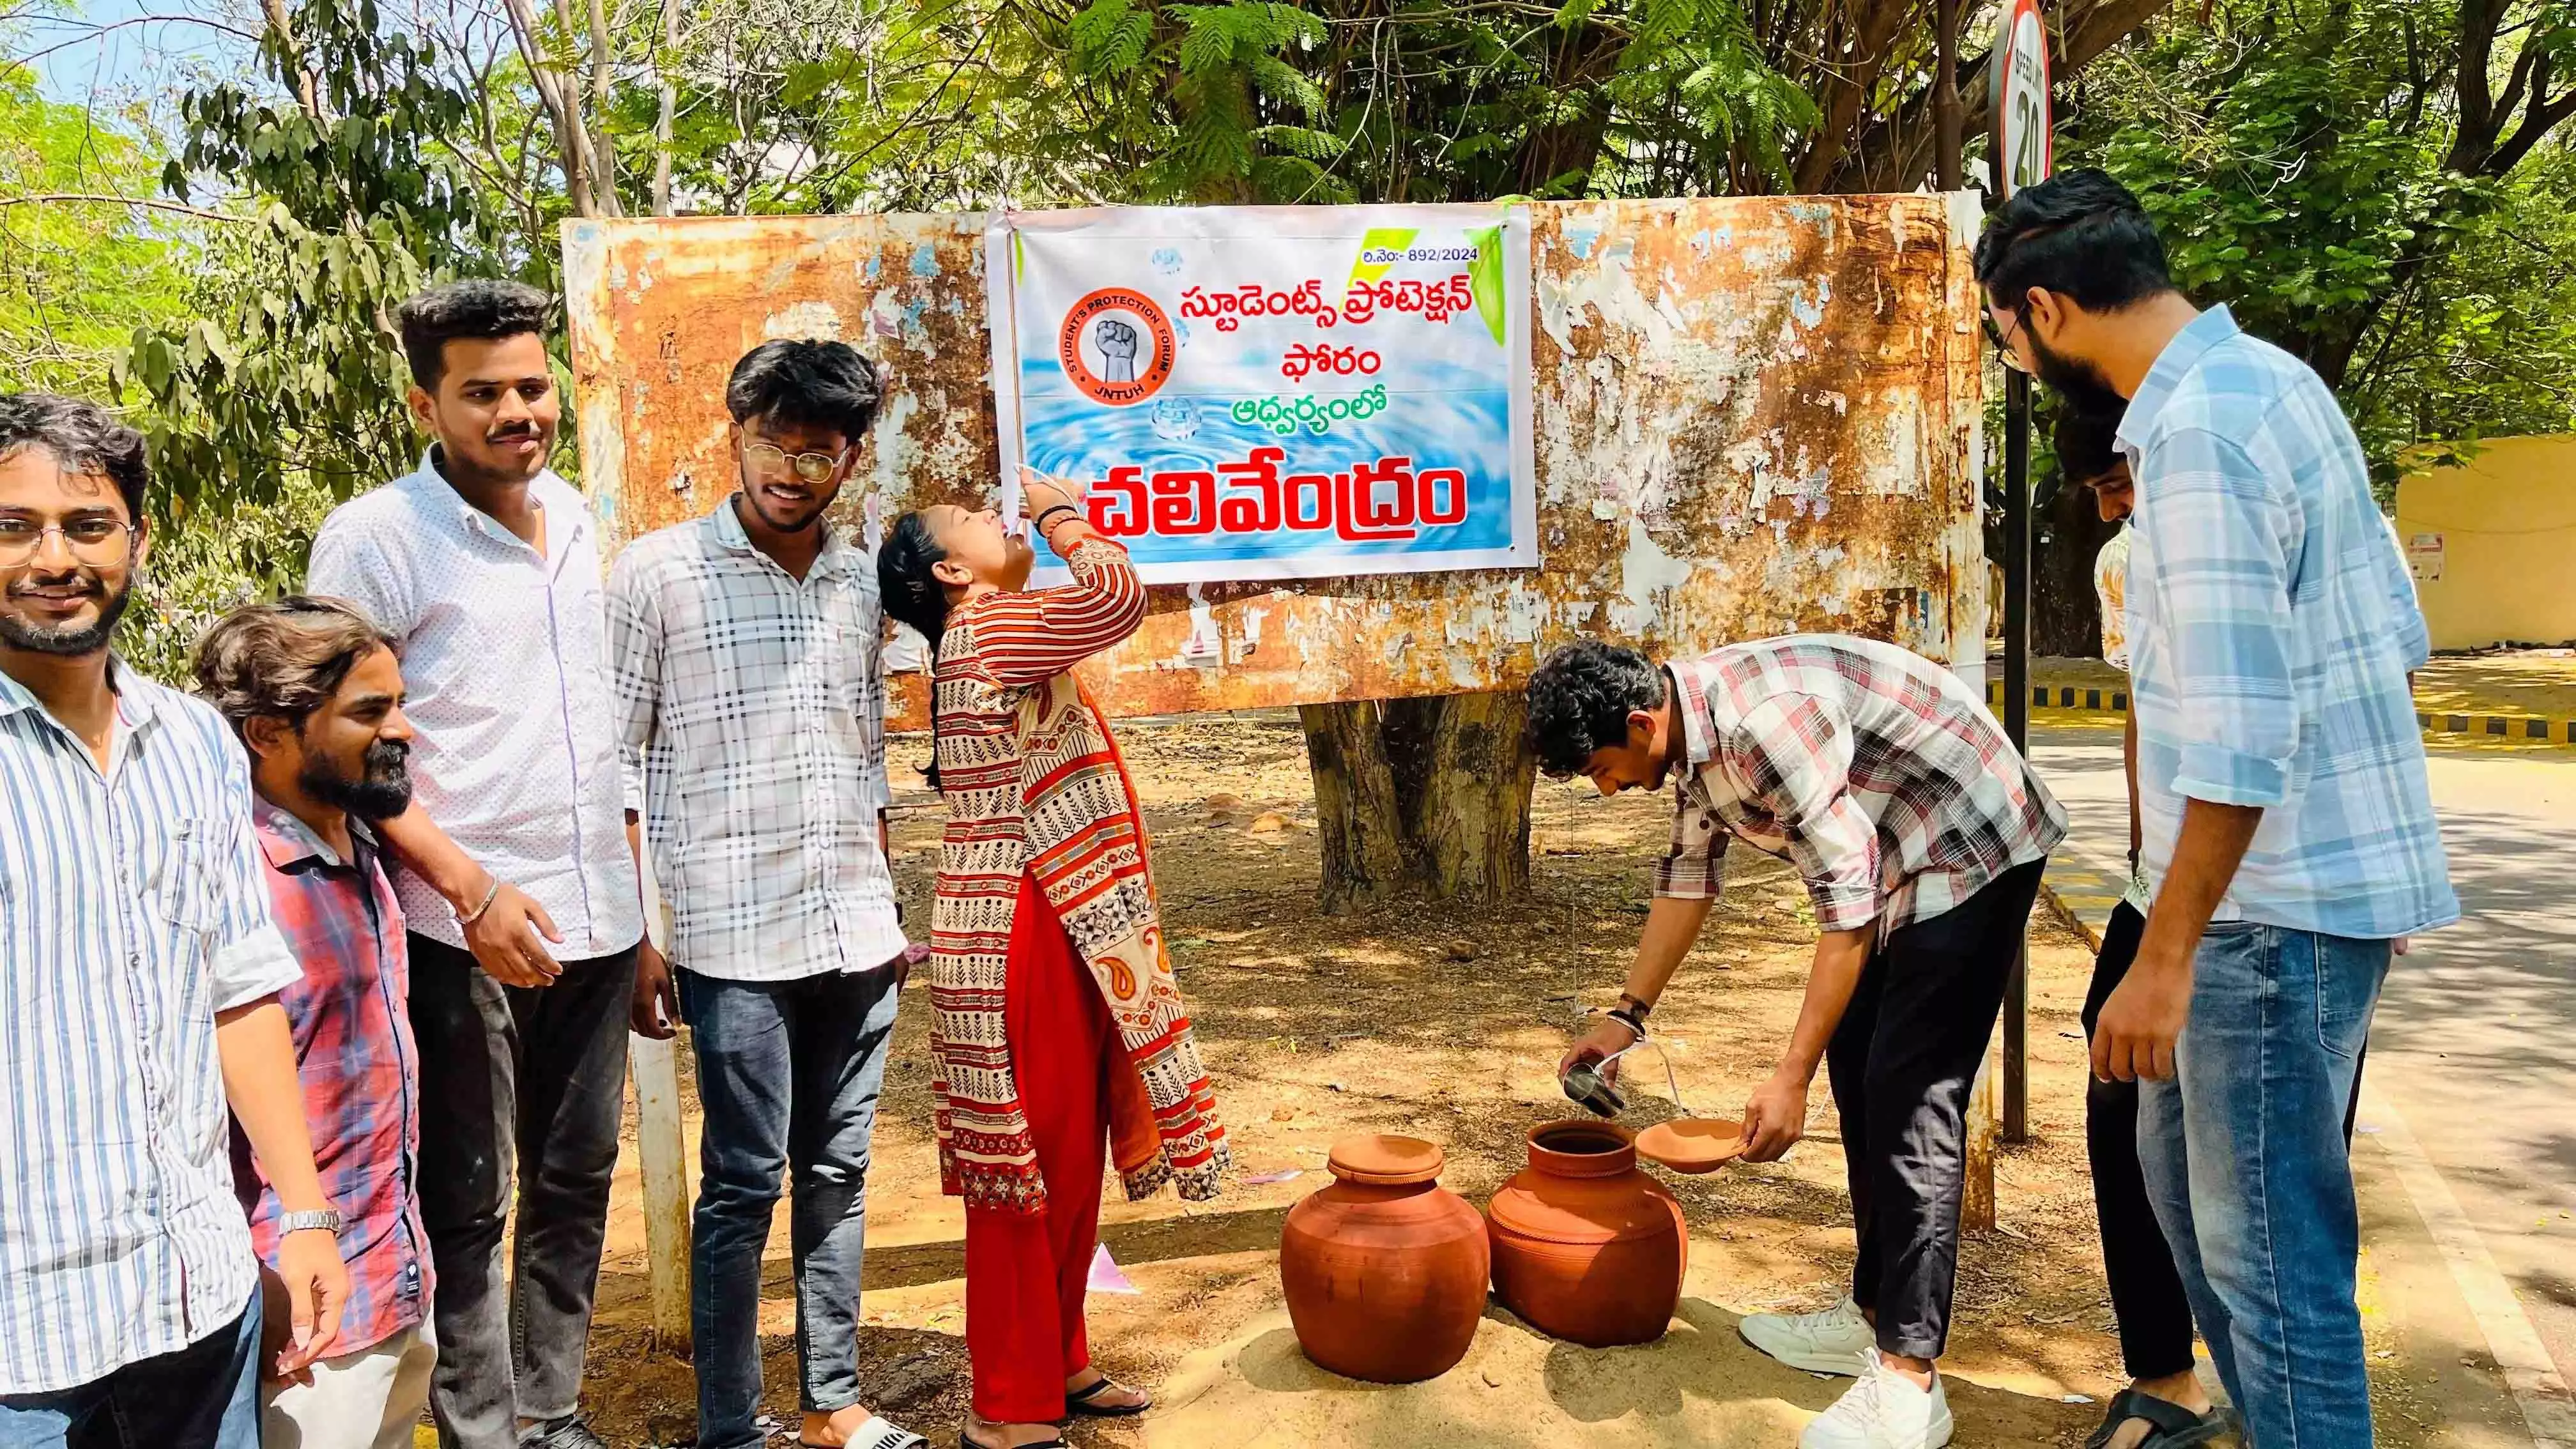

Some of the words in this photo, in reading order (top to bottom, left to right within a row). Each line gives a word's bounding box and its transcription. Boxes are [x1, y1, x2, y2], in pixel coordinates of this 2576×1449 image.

[2014, 91, 2039, 186] 20
[1408, 248, 1478, 263] 892/2024
[1181, 280, 1337, 332] స్టూడెంట్స్
[1342, 275, 1472, 325] ప్రోటెక్షన్
[1064, 309, 1087, 373] STUDENT'S
[1087, 296, 1160, 325] PROTECTION
[1159, 328, 1171, 372] FORUM
[1282, 344, 1381, 383] ఫోరం
[1094, 383, 1145, 400] JNTUH
[1232, 383, 1387, 434] ఆధ్వర్యంలో
[1087, 447, 1467, 540] చలివేంద్రం
